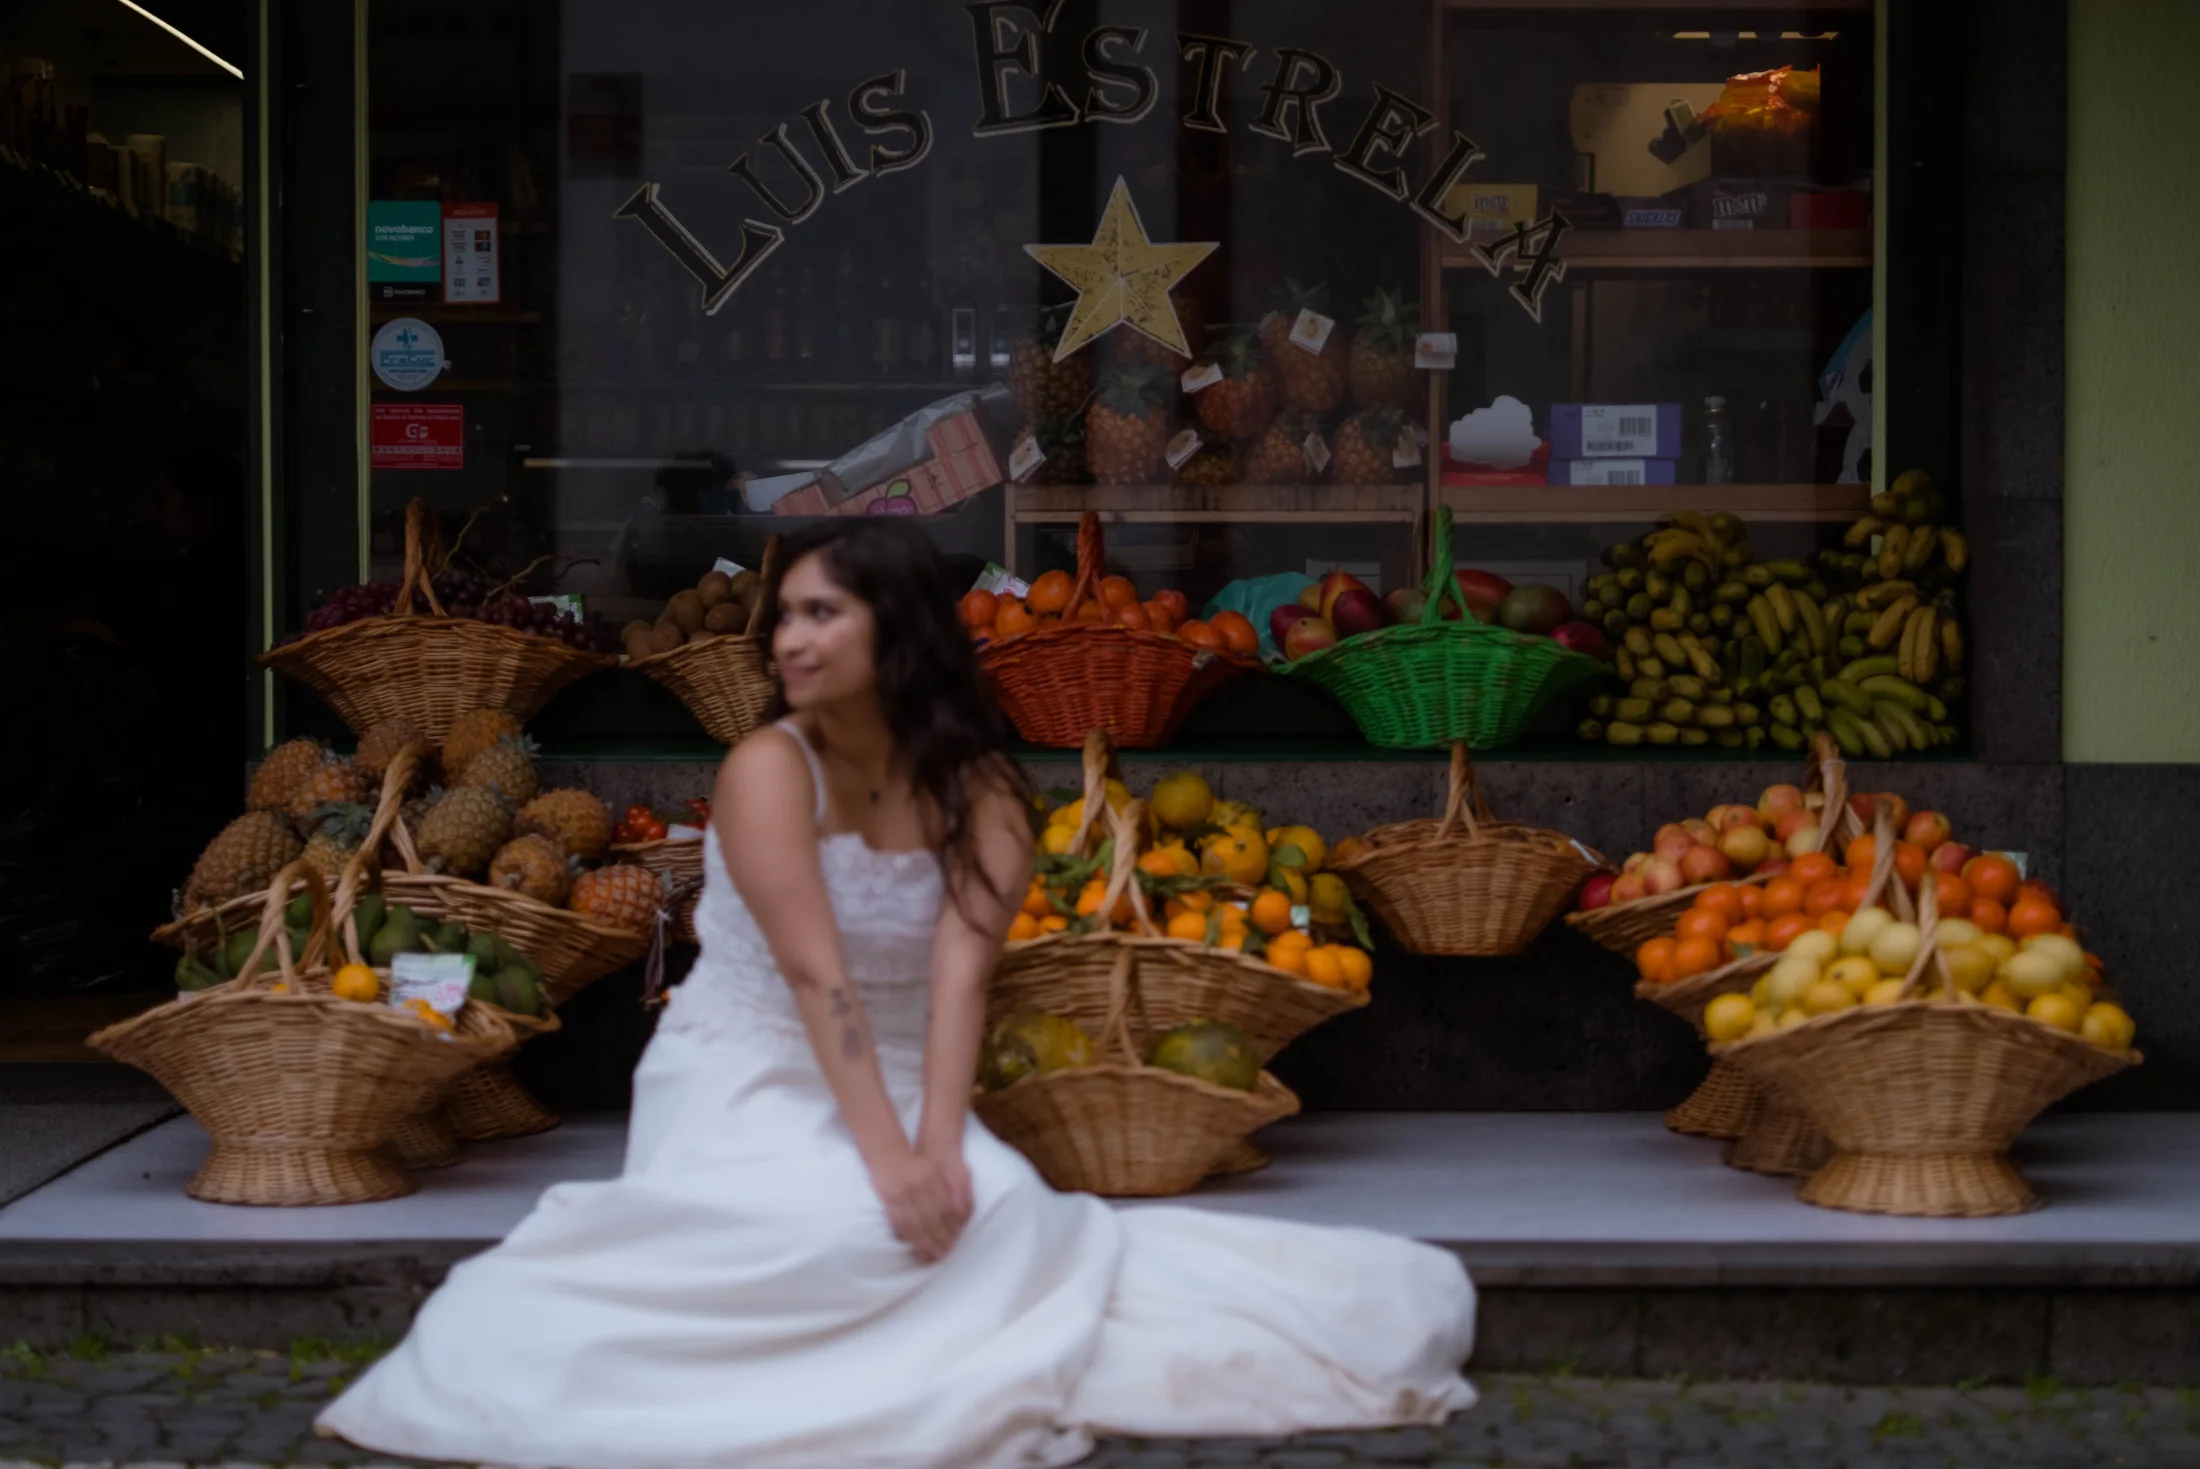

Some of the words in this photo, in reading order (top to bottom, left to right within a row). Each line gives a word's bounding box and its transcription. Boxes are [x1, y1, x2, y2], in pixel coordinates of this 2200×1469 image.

[374, 224, 434, 234] novobanco
[615, 67, 934, 316] LUIS
[963, 0, 1571, 323] ESTRELA
